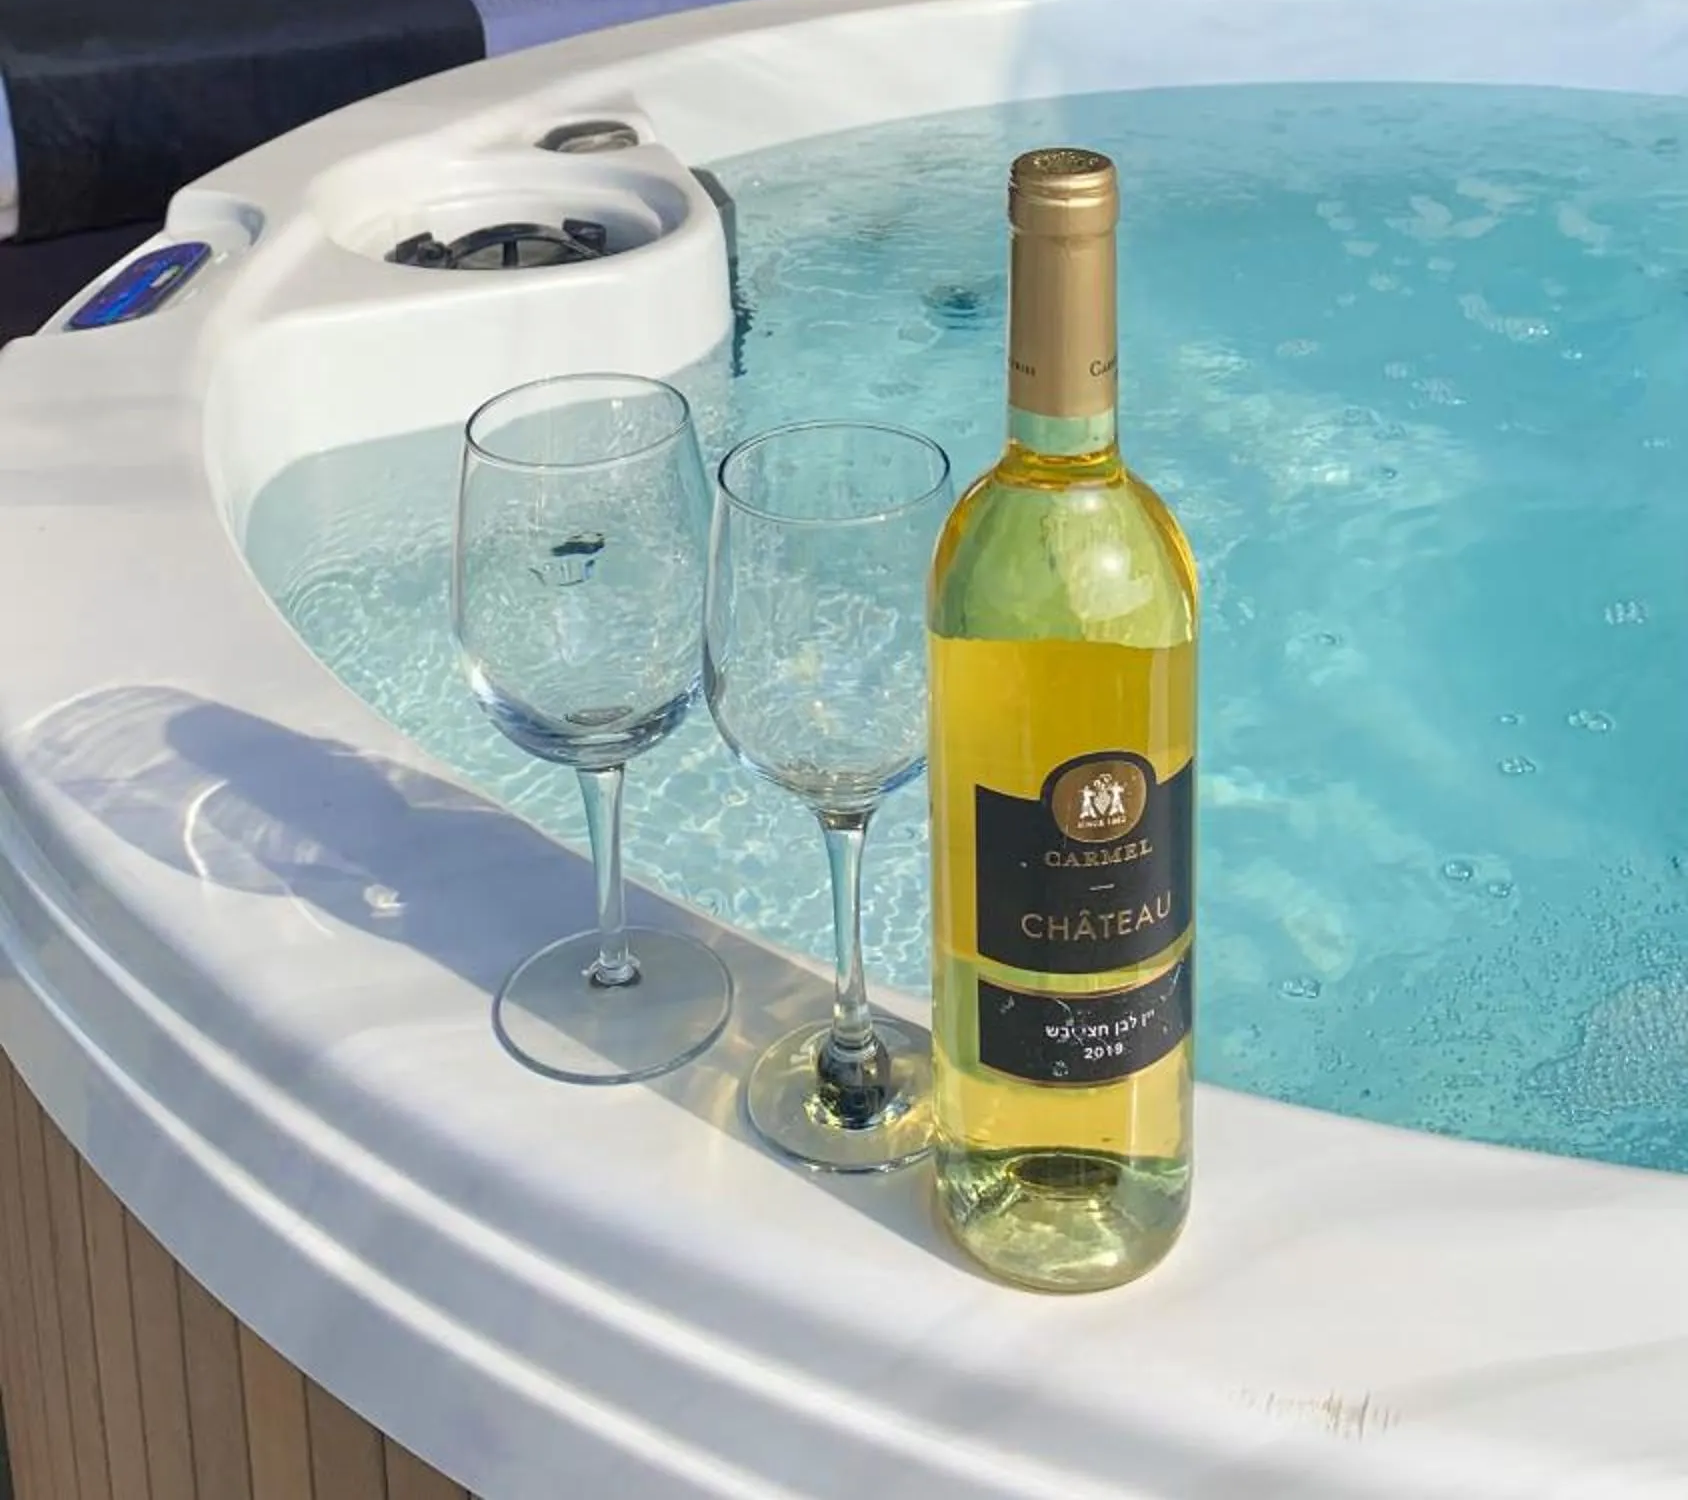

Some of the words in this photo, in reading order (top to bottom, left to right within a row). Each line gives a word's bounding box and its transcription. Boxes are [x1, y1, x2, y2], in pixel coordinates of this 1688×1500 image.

[1044, 839, 1153, 867] CARMEL
[1021, 890, 1171, 941] CHÂTEAU
[1084, 1041, 1123, 1059] 2019
